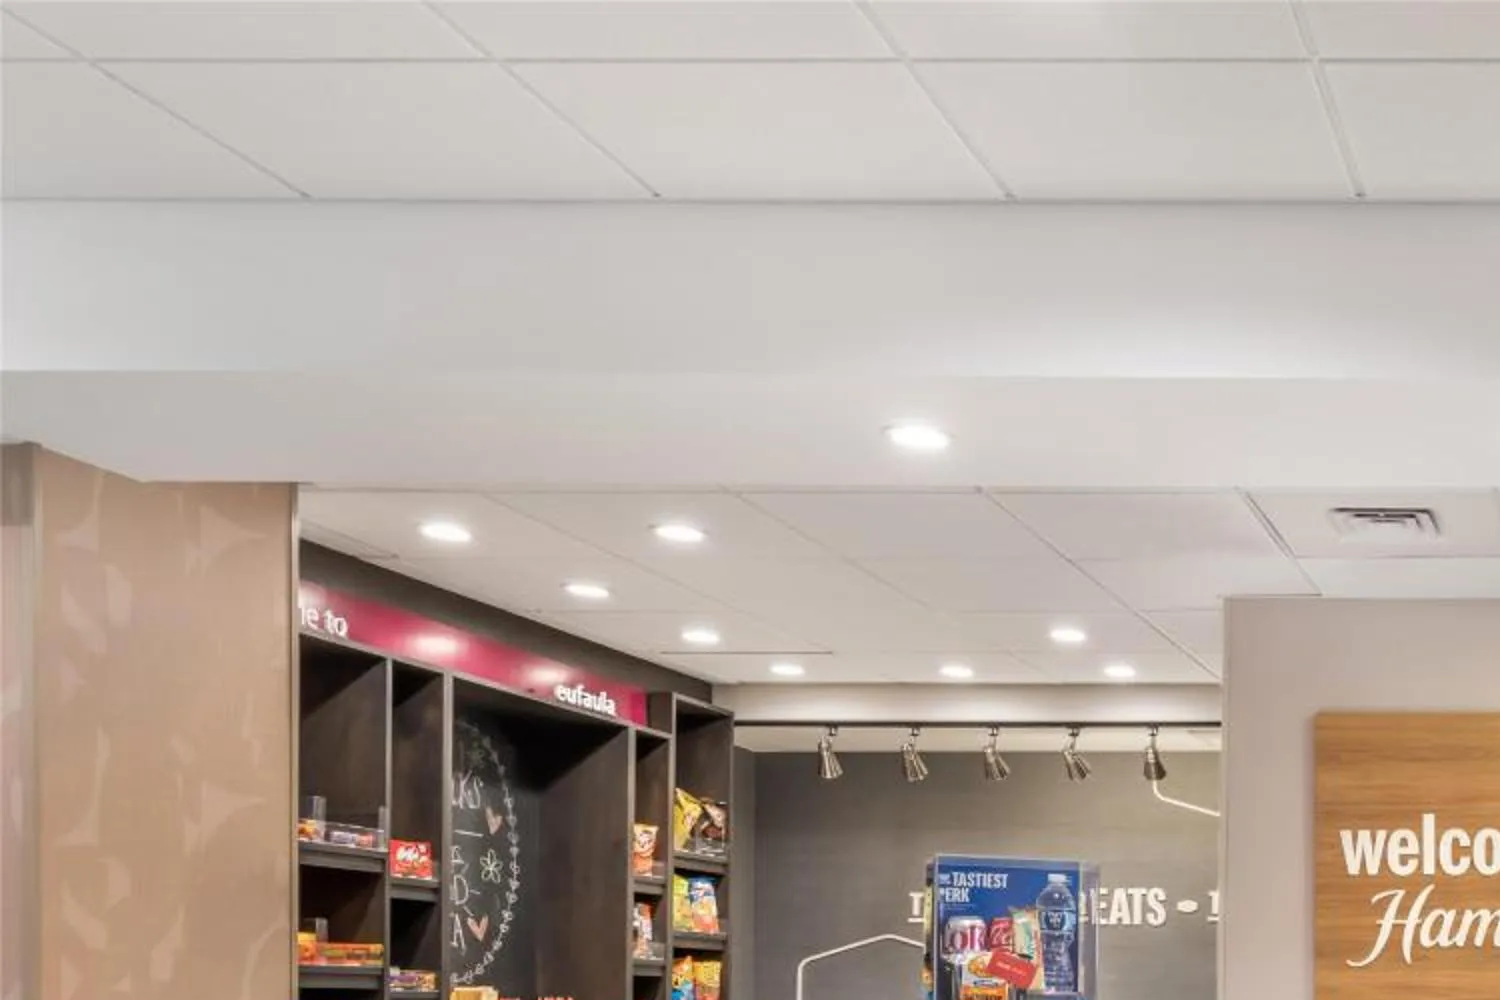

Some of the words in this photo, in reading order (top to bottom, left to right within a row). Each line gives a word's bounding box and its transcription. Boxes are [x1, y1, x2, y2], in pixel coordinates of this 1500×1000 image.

[323, 608, 349, 637] to
[554, 684, 617, 717] eufaula
[952, 871, 1009, 889] TASTIEST
